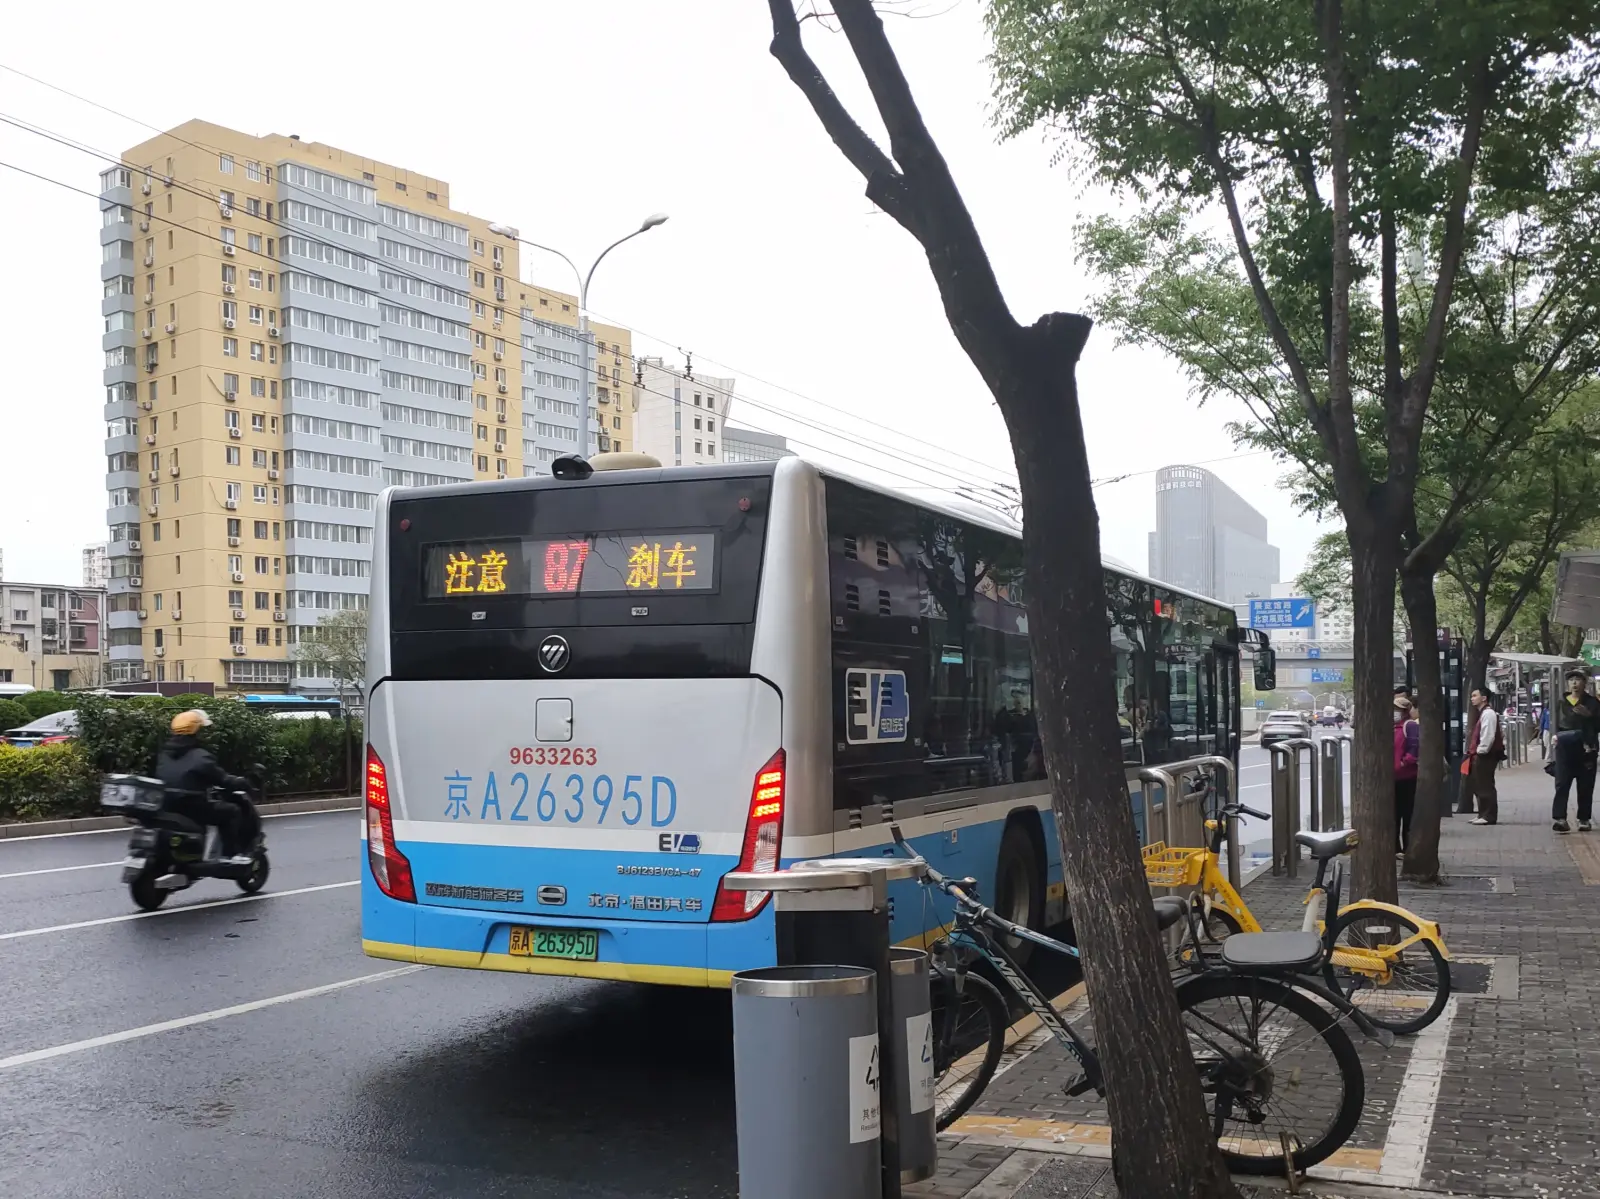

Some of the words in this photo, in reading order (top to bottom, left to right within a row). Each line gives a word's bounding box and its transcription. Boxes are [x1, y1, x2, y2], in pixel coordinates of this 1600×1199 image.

[446, 550, 508, 593] 注意
[544, 542, 588, 591] 87
[626, 542, 697, 588] 刹车
[1254, 614, 1293, 624] 北京展览馆
[509, 747, 598, 766] 9633263
[443, 769, 677, 828] 京A26395D
[990, 956, 1075, 1043] MERIDA
